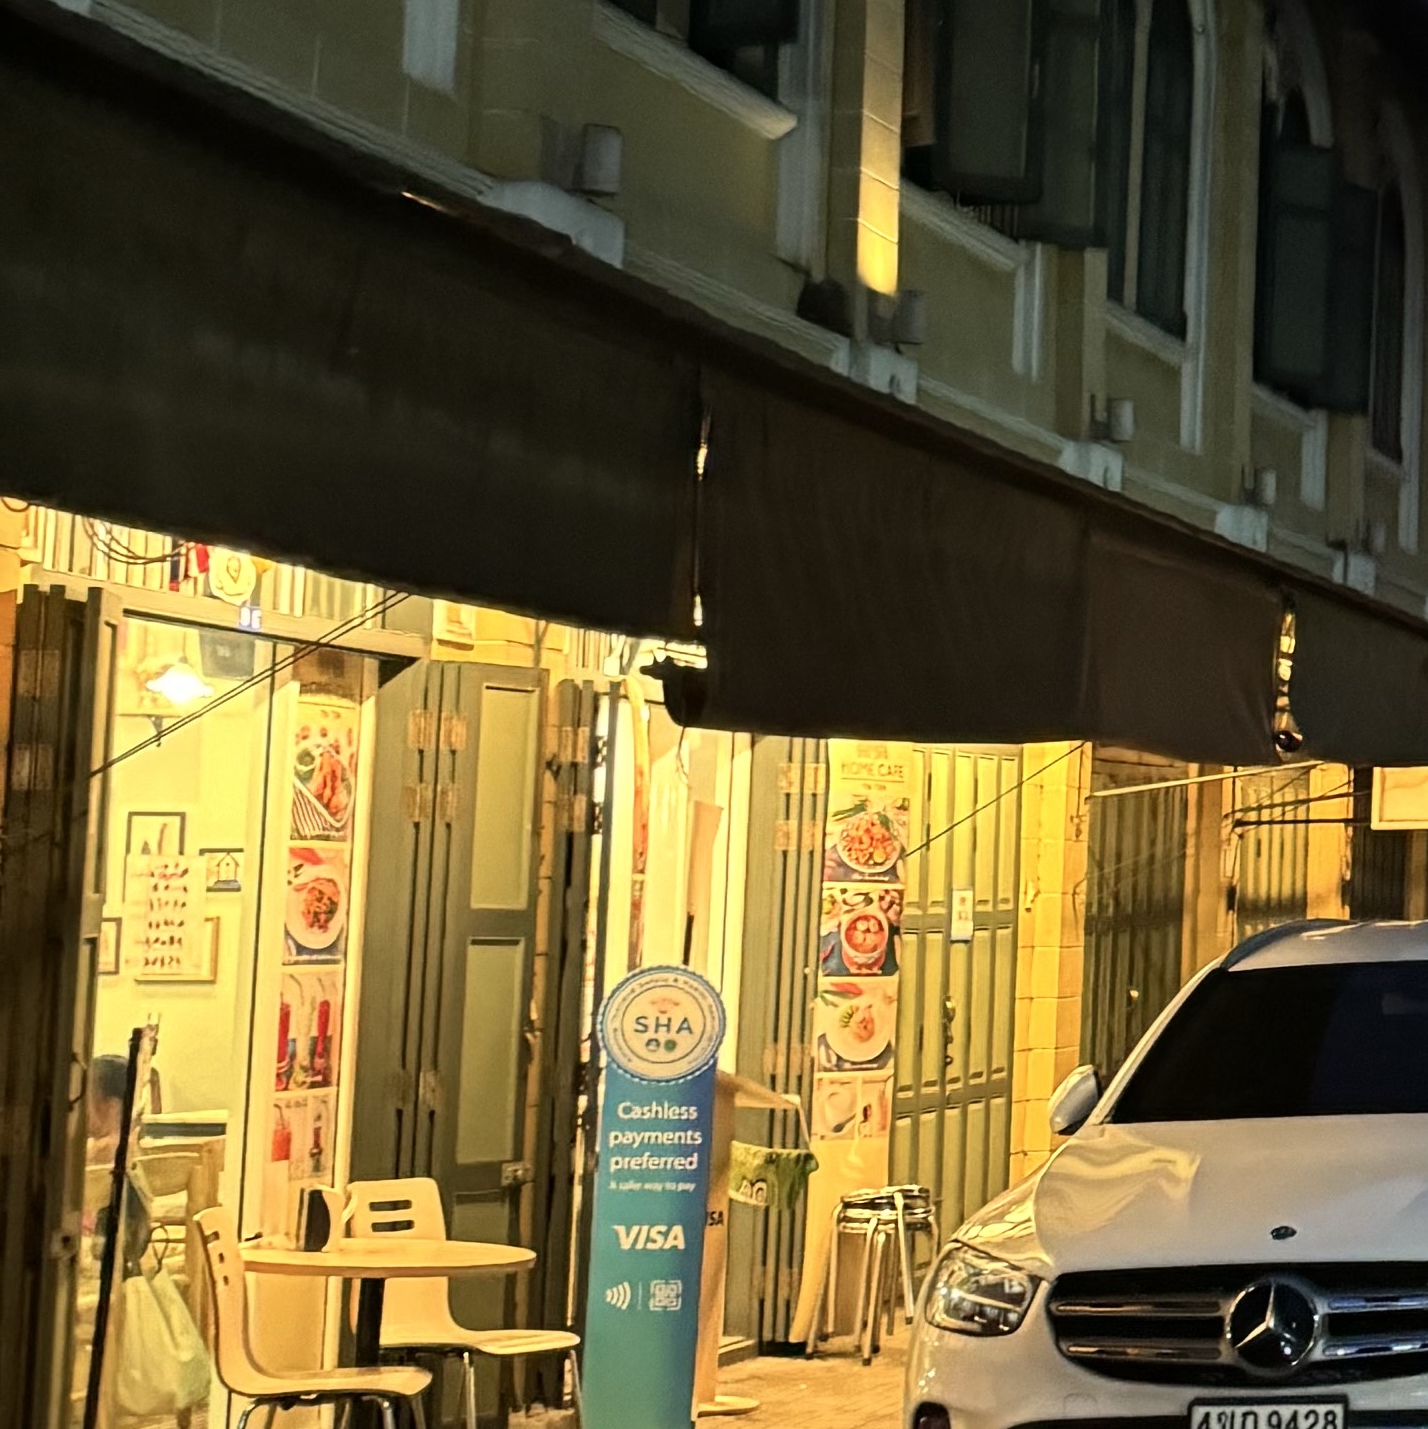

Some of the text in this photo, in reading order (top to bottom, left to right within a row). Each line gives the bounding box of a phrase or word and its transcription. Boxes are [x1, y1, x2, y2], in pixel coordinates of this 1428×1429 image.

[634, 1016, 693, 1034] SHA
[617, 1101, 698, 1119] Cashless
[609, 1130, 702, 1148] payments
[610, 1152, 698, 1172] preferred
[612, 1225, 685, 1250] VISA
